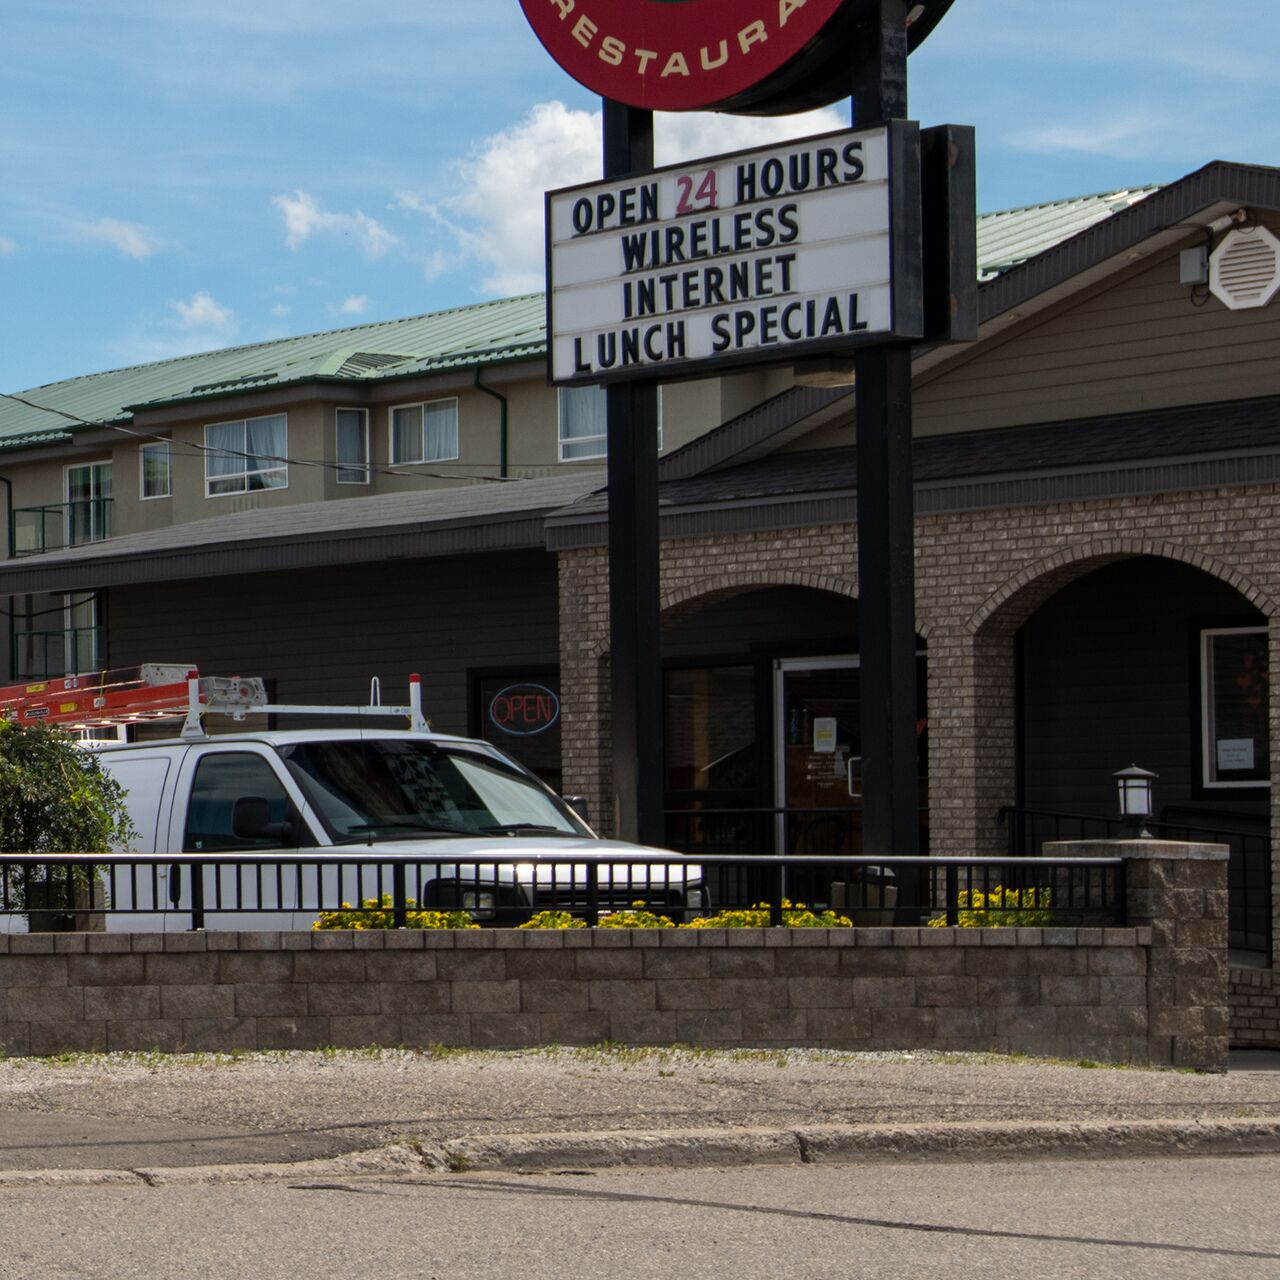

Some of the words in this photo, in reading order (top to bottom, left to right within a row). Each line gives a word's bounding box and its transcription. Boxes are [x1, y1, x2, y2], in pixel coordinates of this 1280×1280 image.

[572, 183, 659, 235] OPEN
[676, 170, 718, 215] 24
[737, 141, 864, 202] HOURS
[622, 203, 799, 272] WIRELESS
[622, 252, 797, 319] INTERNET
[574, 320, 686, 374] LUNCH
[711, 293, 868, 353] SPECIAL
[494, 695, 552, 723] OPEN
